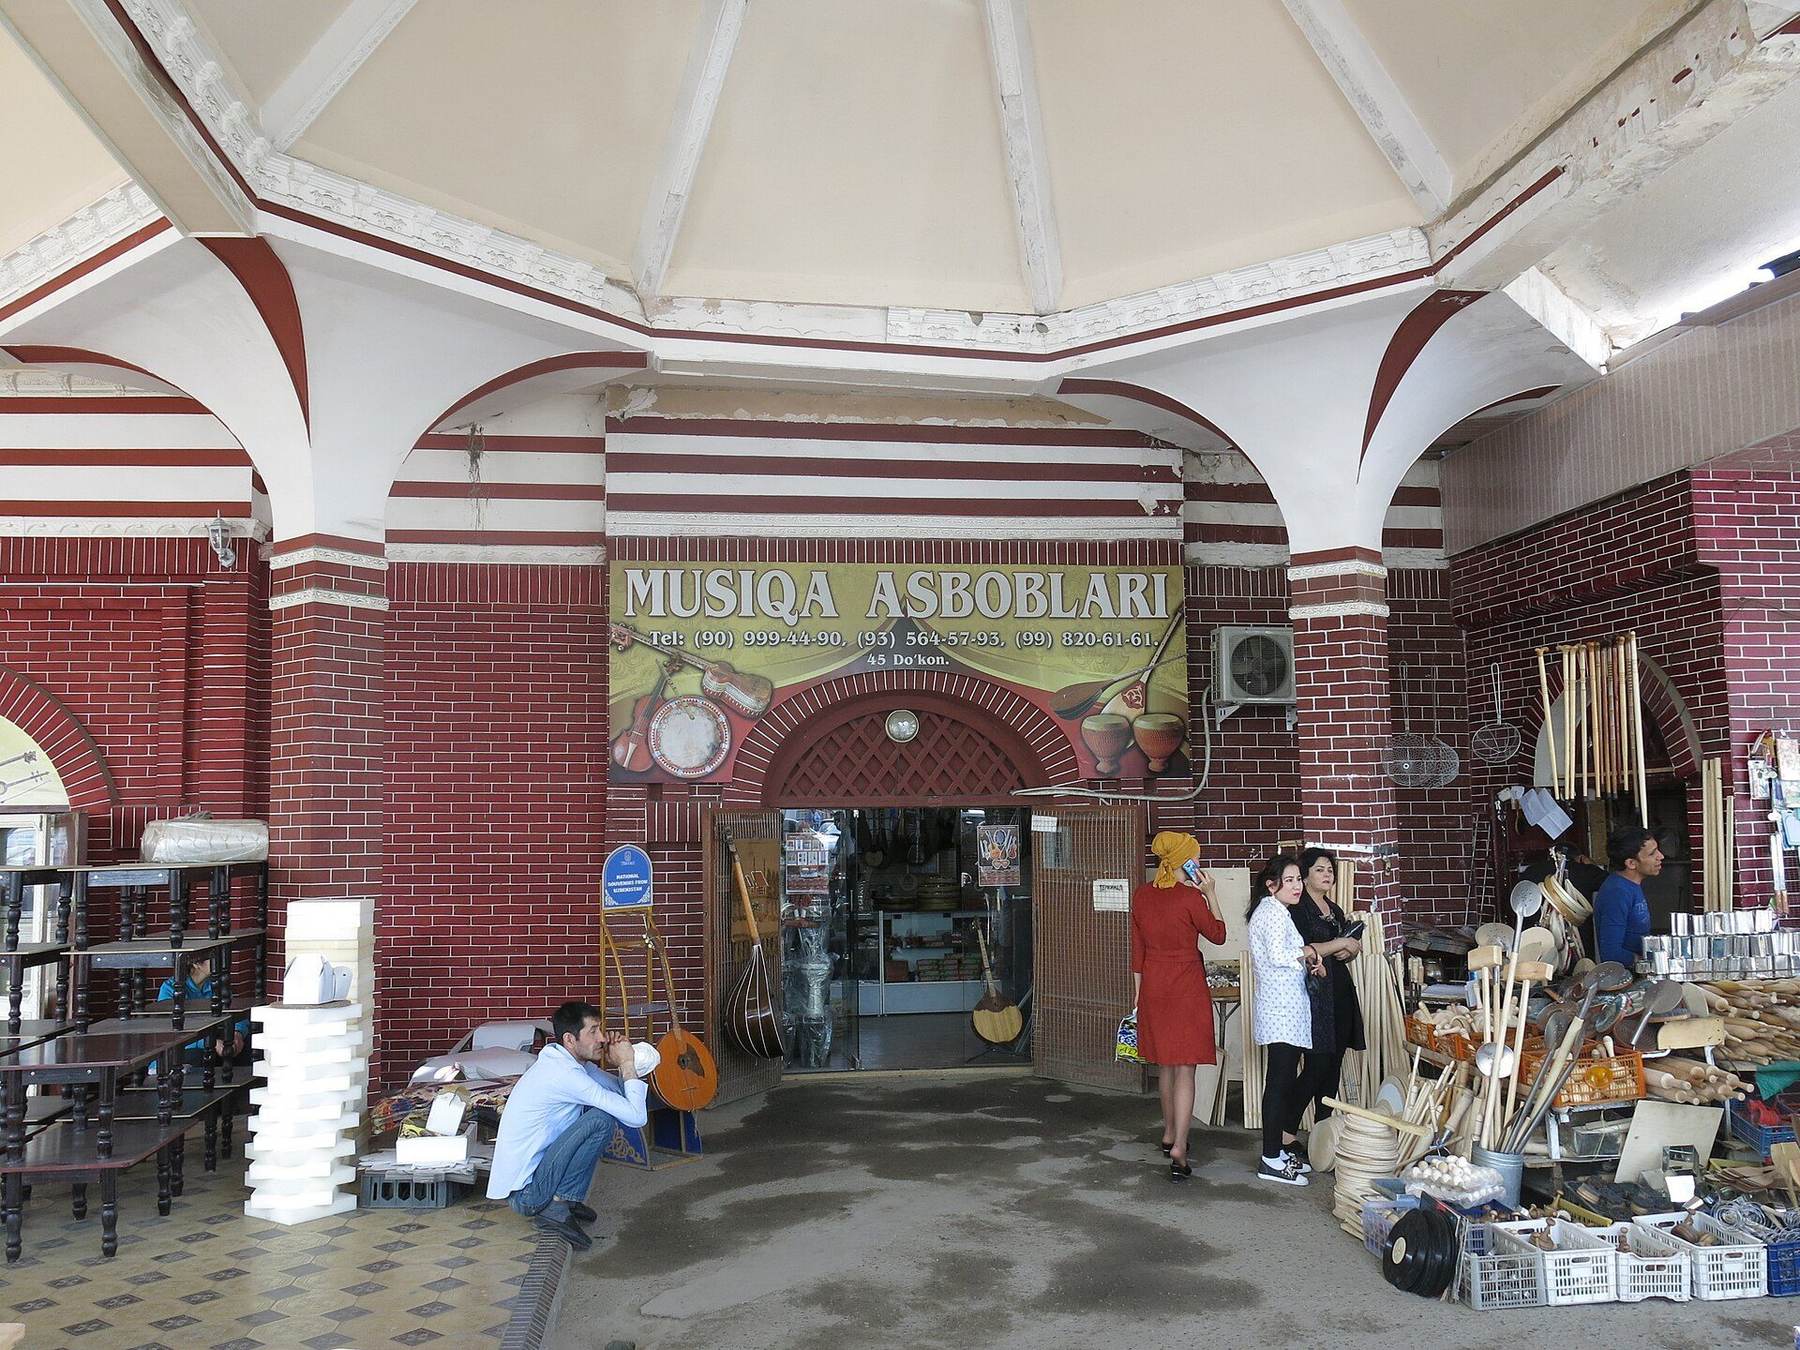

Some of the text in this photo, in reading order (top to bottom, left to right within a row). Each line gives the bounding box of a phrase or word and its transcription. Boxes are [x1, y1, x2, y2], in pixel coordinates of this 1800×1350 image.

[624, 568, 1170, 627] MUSIQA ASBOBLARI
[650, 630, 1160, 650] Tel: (90) 999-44-90, (93) 564-57-93, (99) 820-61-61.
[866, 653, 887, 666] 45
